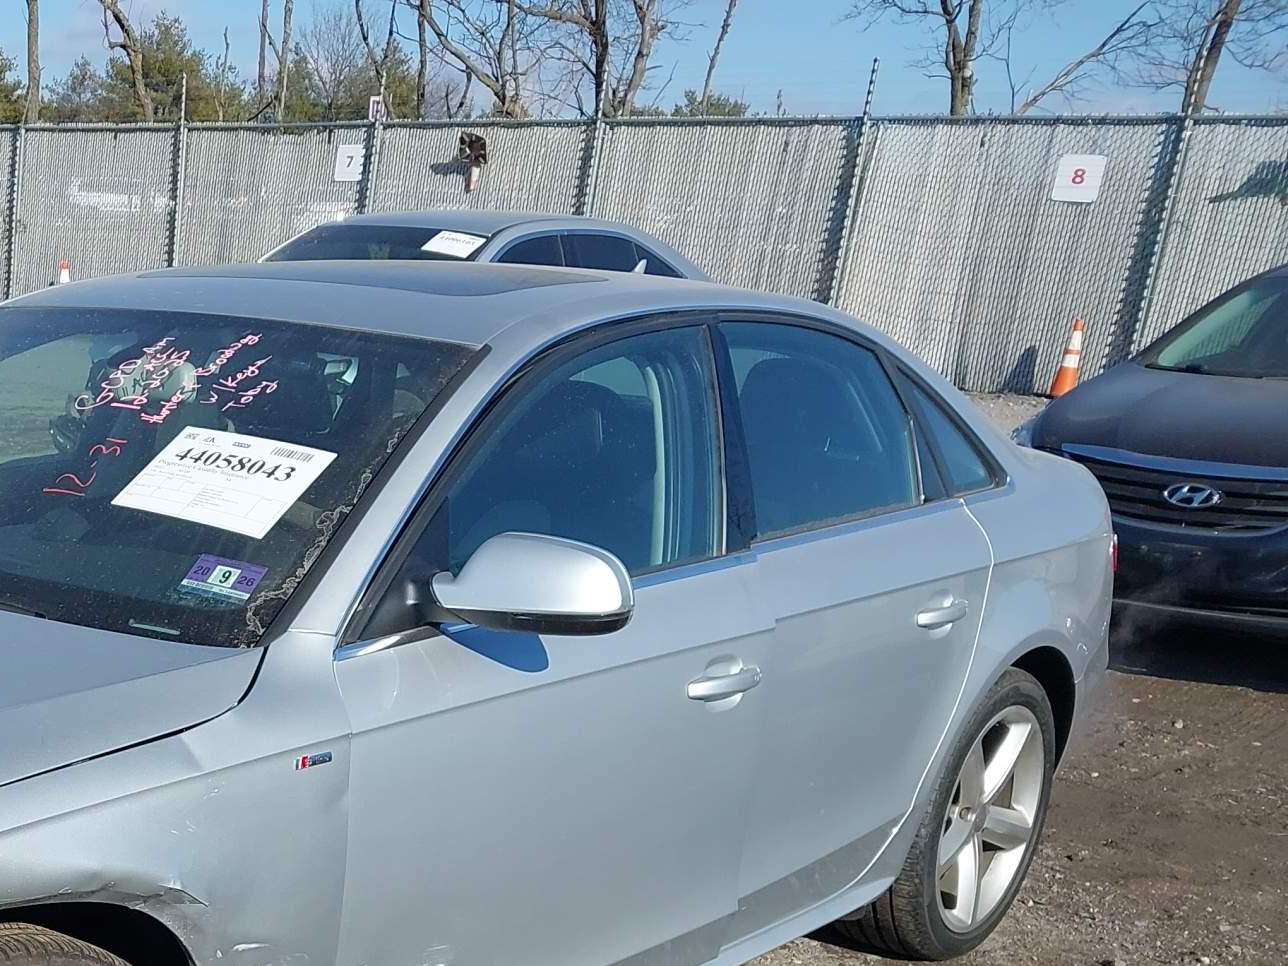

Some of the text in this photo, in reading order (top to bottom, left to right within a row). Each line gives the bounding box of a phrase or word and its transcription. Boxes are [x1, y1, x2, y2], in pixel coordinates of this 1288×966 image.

[345, 155, 354, 168] 7
[1071, 168, 1087, 185] 8
[43, 438, 129, 497] 12-31
[175, 447, 297, 483] 44058043
[193, 565, 256, 587] 20 9 26
